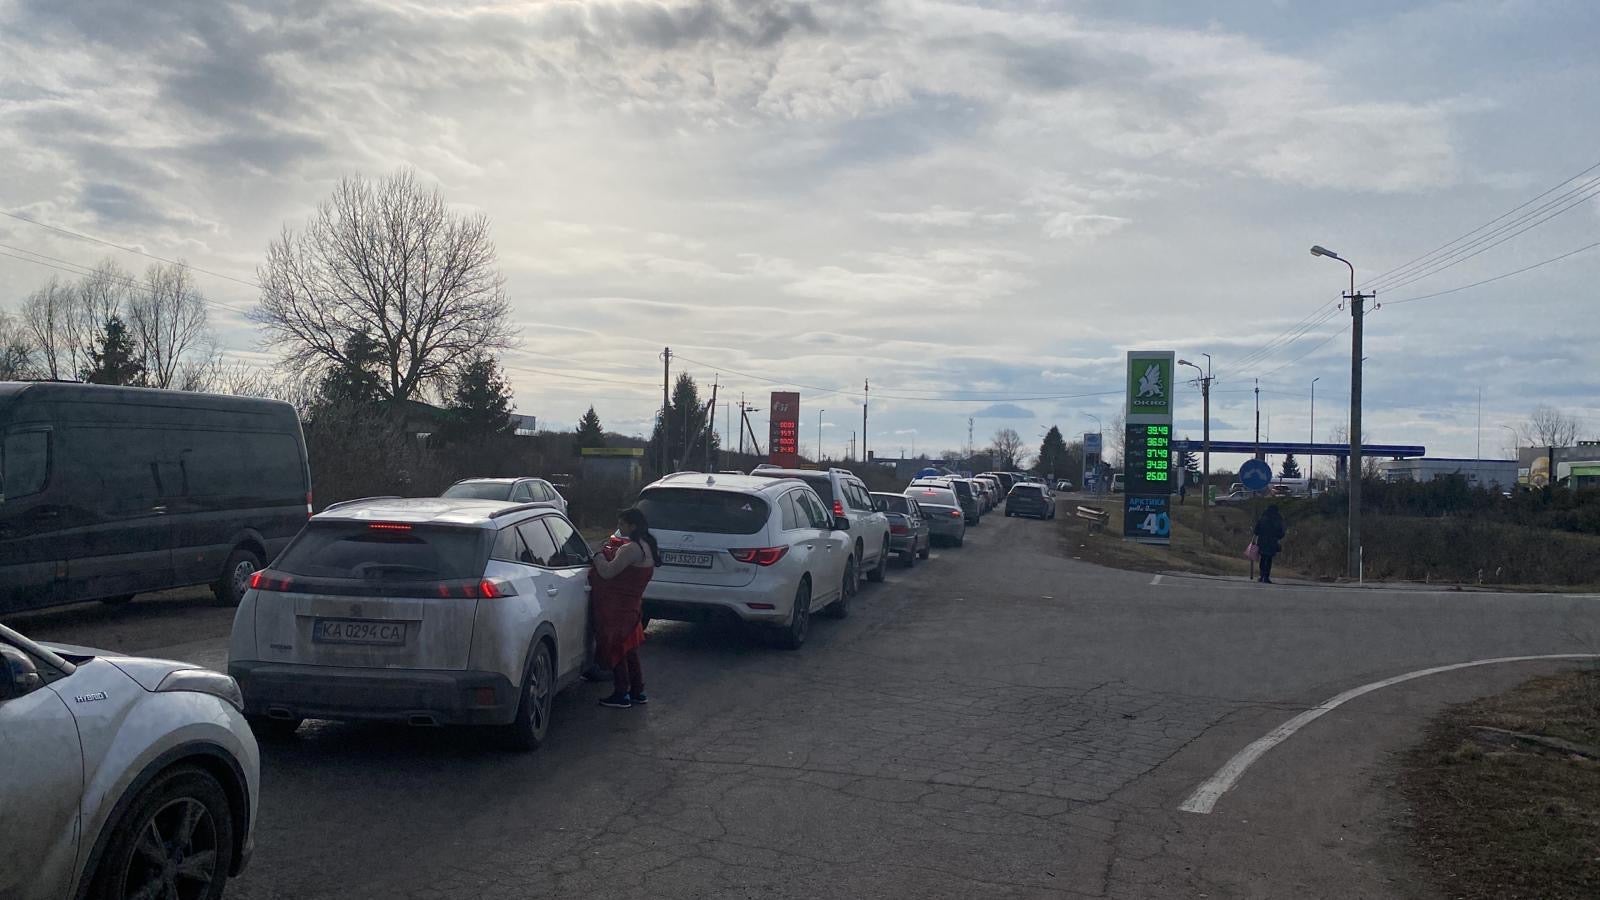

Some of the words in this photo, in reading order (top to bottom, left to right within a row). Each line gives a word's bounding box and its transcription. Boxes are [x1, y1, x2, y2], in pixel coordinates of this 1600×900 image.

[1146, 449, 1168, 458] 37.49
[322, 623, 341, 637] KA
[346, 624, 377, 639] 0294
[380, 626, 400, 639] CA
[74, 691, 108, 703] HYBRID
